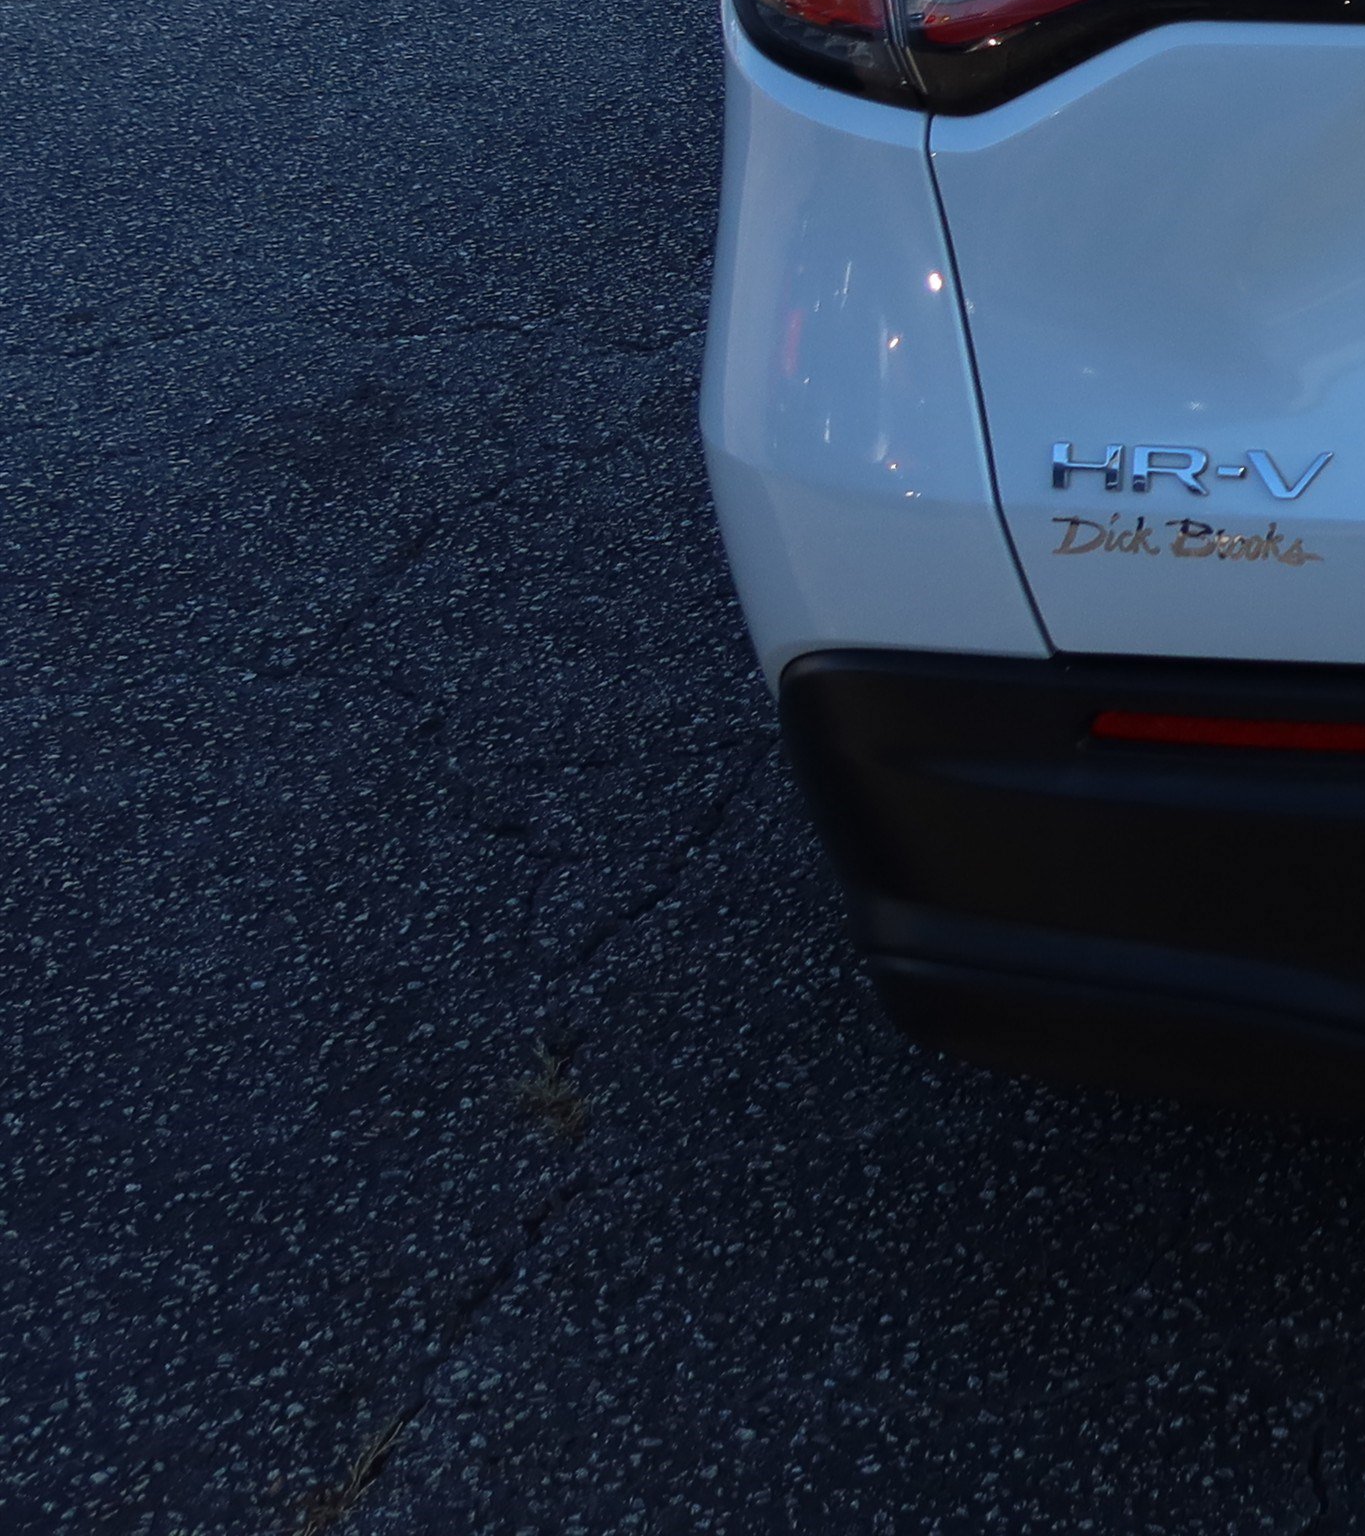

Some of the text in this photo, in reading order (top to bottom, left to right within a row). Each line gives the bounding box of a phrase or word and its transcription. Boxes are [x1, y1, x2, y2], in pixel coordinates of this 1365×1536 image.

[1051, 441, 1335, 501] HR-V
[1052, 512, 1324, 567] Dick Brooks
